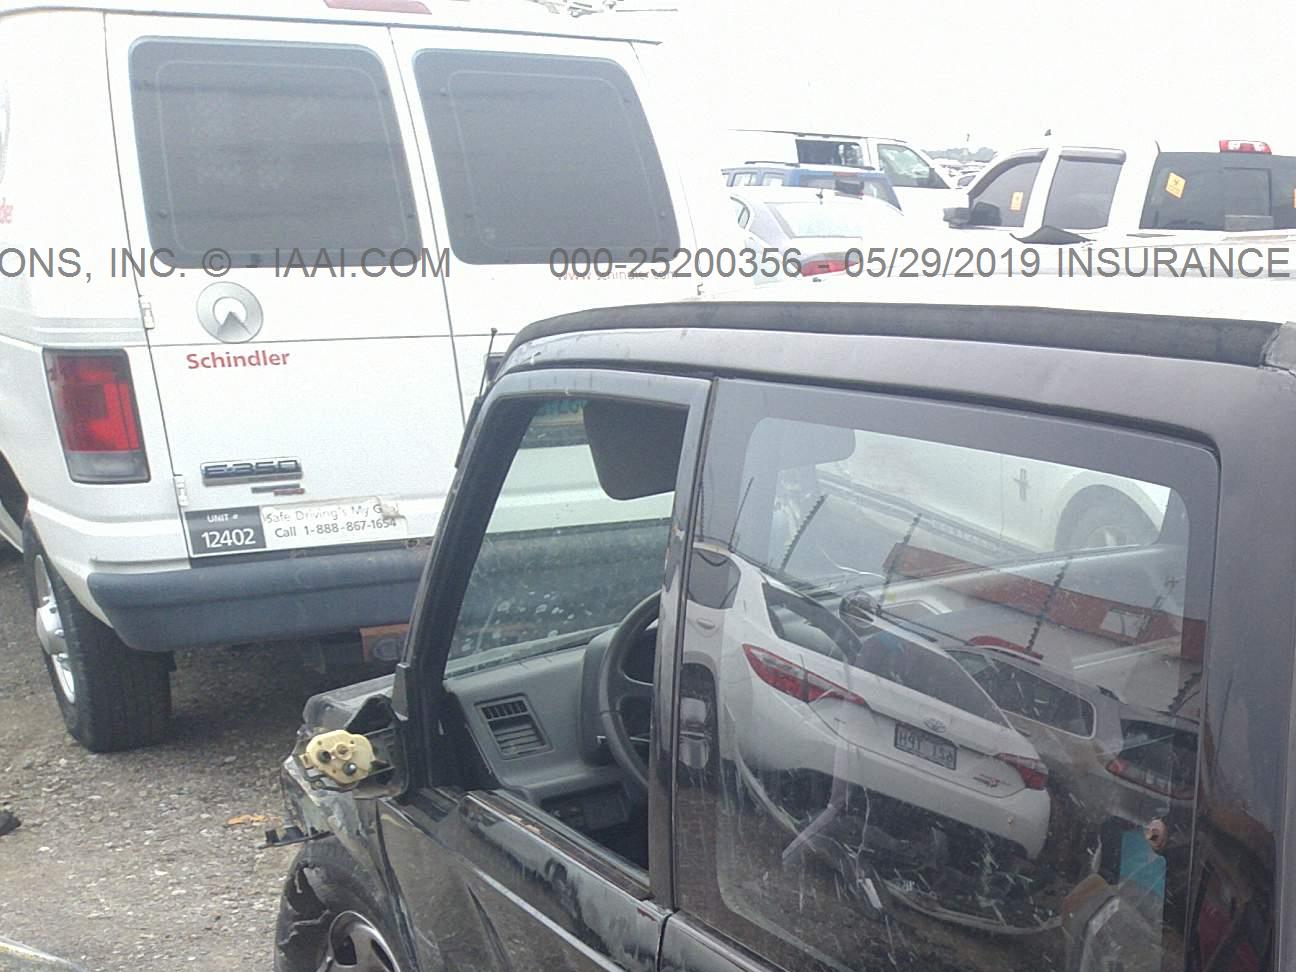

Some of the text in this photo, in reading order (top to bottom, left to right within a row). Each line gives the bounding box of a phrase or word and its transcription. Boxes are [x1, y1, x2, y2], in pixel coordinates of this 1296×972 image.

[186, 350, 290, 369] Schindler
[207, 514, 229, 524] UNIT
[265, 503, 399, 523] Safe Driving's My Gl
[274, 518, 397, 538] Call 1-888-867-1654
[201, 528, 256, 549] 12402
